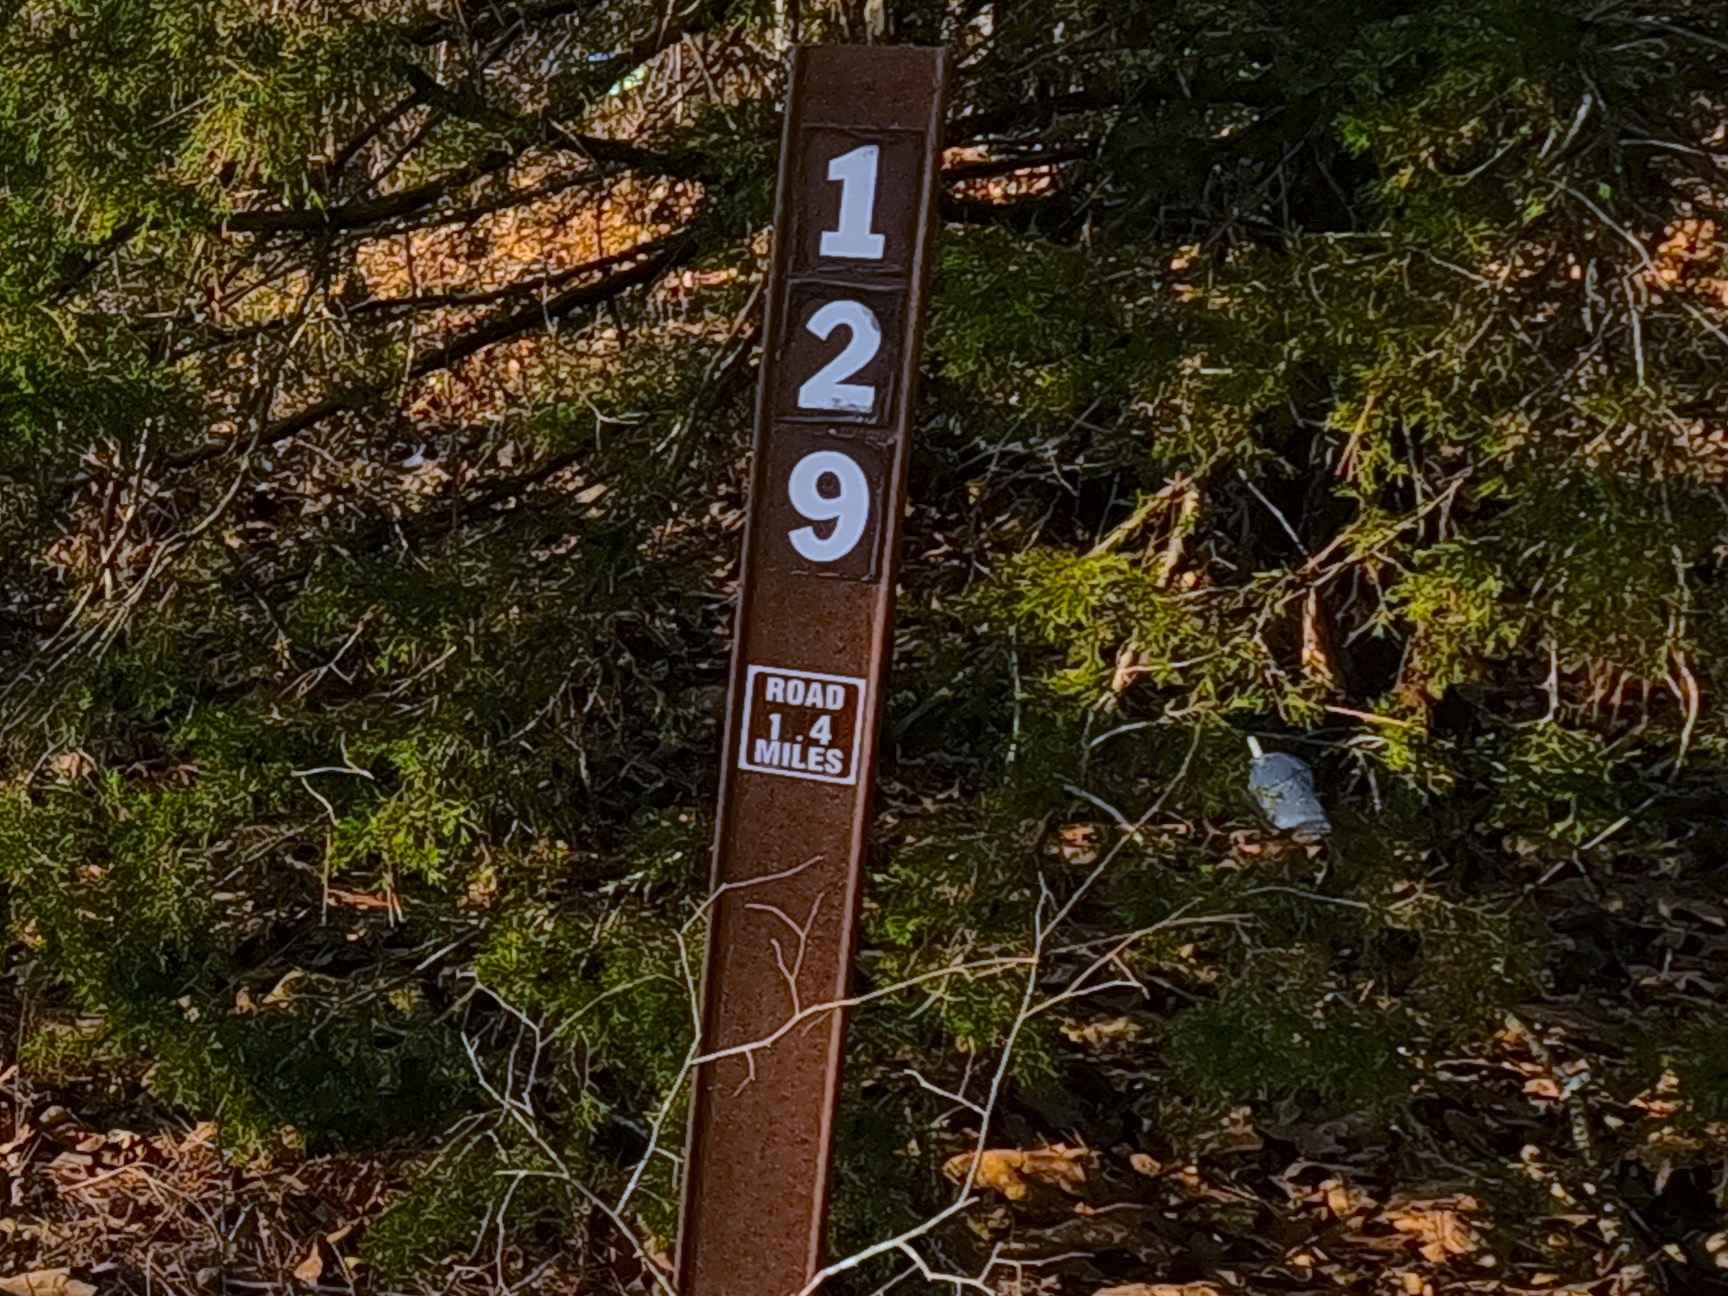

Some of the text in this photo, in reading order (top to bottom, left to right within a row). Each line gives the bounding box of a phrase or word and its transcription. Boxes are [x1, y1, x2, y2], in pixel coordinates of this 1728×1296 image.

[765, 676, 846, 710] ROAD
[768, 712, 833, 745] 1.4
[753, 738, 845, 774] MILES
